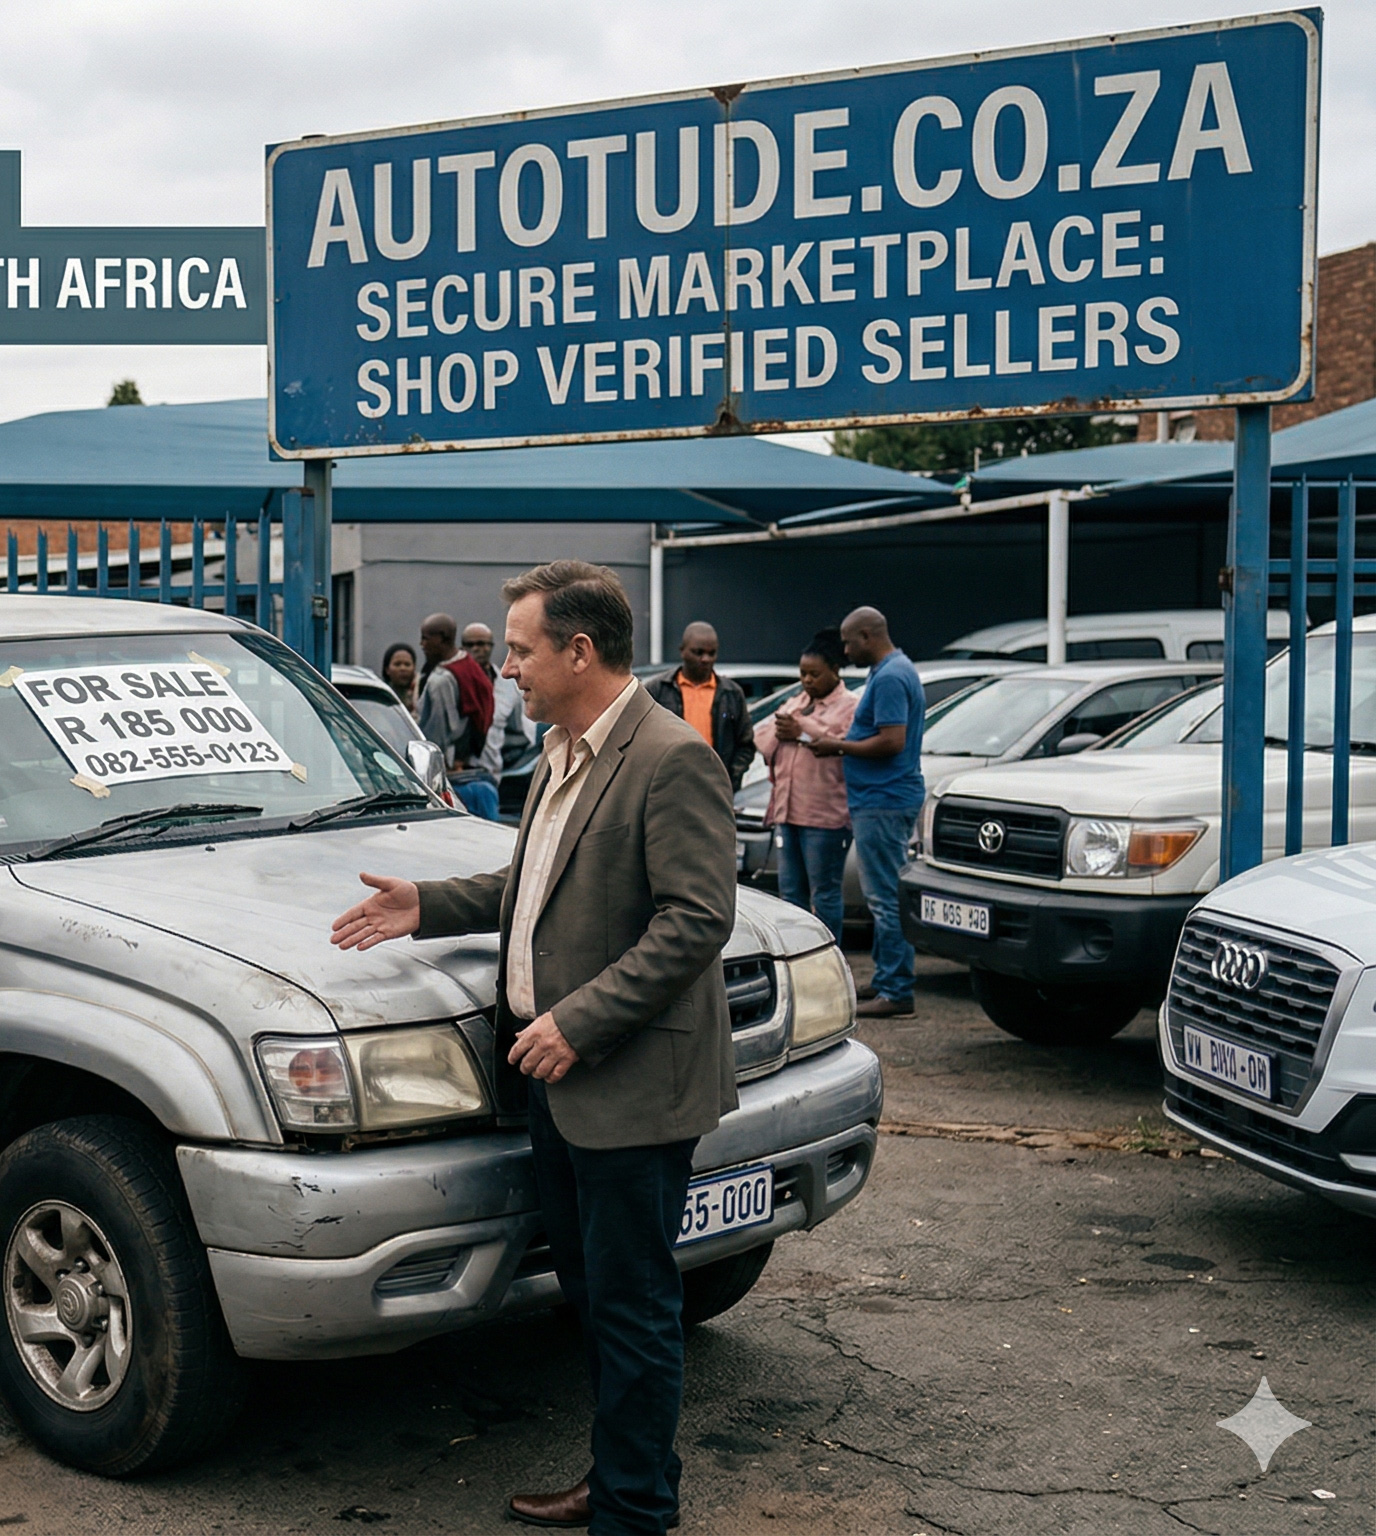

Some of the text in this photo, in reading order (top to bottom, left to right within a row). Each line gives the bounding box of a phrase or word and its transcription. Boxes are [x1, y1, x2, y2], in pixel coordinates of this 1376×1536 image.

[307, 61, 1253, 269] AUTOTUDE.CO.ZA
[356, 208, 1166, 343] SECURE MARKETPLACE:
[356, 296, 1181, 420] SHOP VERIFIED SELLERS
[25, 670, 228, 707] FOR SALE
[55, 706, 254, 745] R 185 000
[85, 741, 279, 778] 082-555-0123
